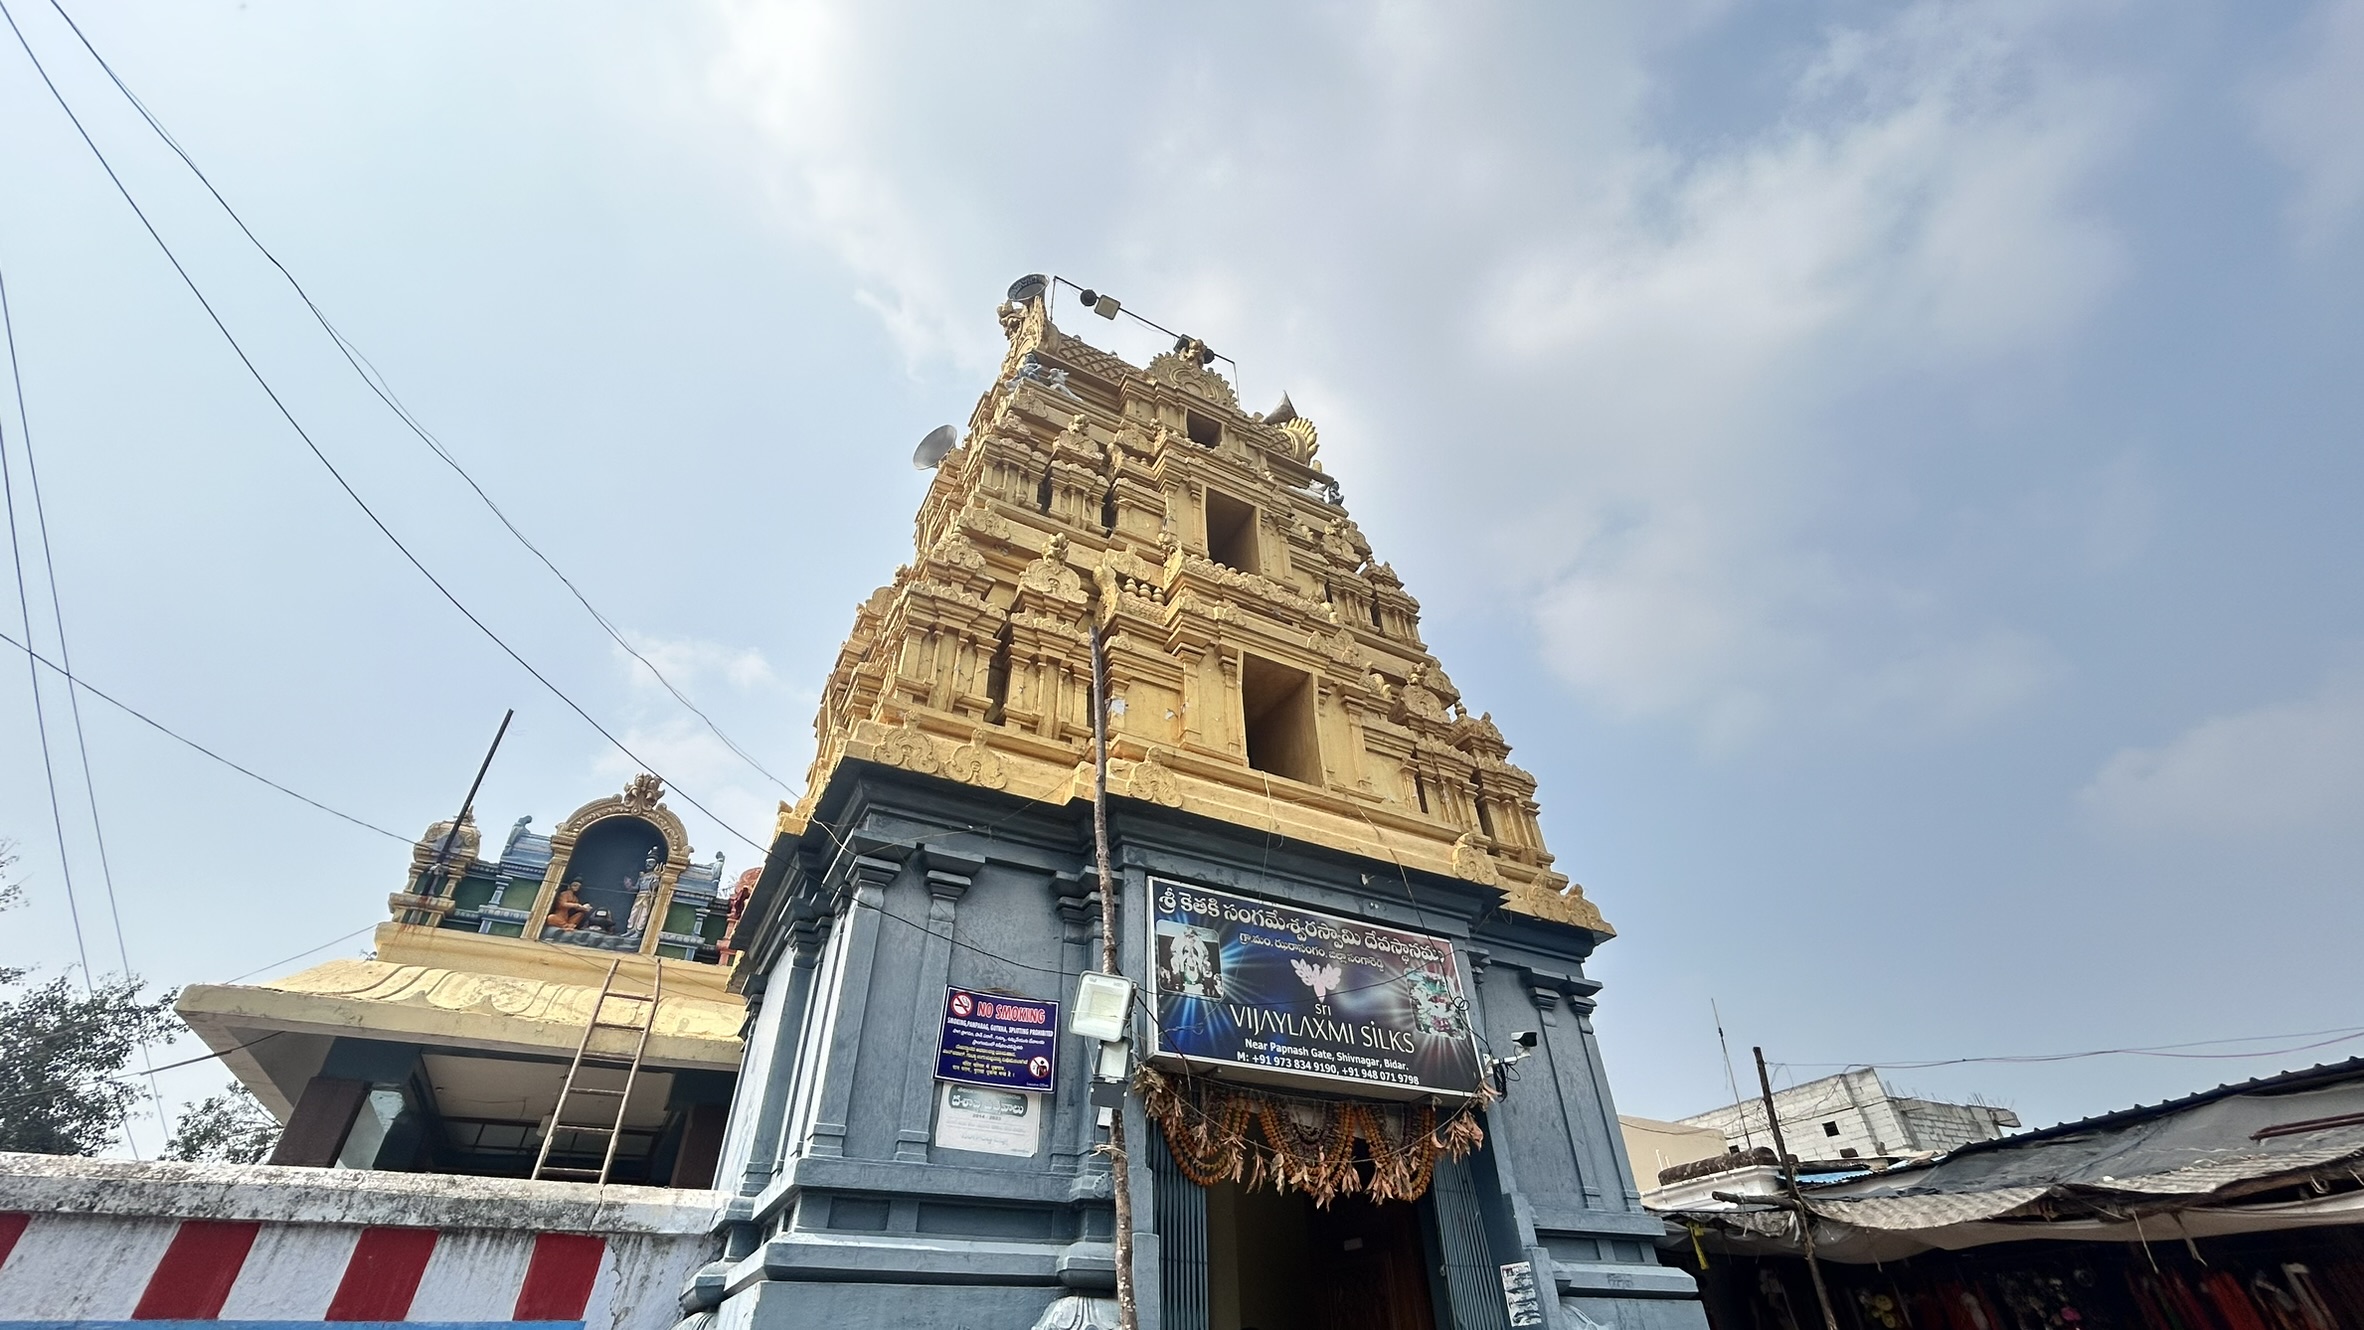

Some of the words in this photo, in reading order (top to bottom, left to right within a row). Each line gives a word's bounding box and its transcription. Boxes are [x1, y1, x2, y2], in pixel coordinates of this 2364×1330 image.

[1158, 888, 1176, 914] శ్రీ
[1223, 903, 1361, 949] సంగమేశ్వరస్వామి
[1364, 930, 1445, 964] దేవస్థానము
[976, 1001, 994, 1018] NO
[995, 1004, 1046, 1024] SMOKING
[1229, 1004, 1355, 1044] VIJAYLAXMI
[1236, 1051, 1249, 1062] M:
[1252, 1054, 1272, 1065] +91
[1273, 1056, 1292, 1067] 973
[1293, 1060, 1312, 1070] 834
[1313, 1062, 1340, 1075] 9190,
[1342, 1066, 1360, 1077] +91
[1361, 1069, 1378, 1080] 948
[1380, 1071, 1397, 1082] 071
[1397, 1073, 1420, 1085] 9798
[1244, 1038, 1267, 1051] Near
[1270, 1041, 1309, 1057] Papnash
[1310, 1047, 1335, 1061] Gate,
[1336, 1051, 1383, 1069] Shivnagar,
[1383, 1058, 1409, 1070] Bidar.
